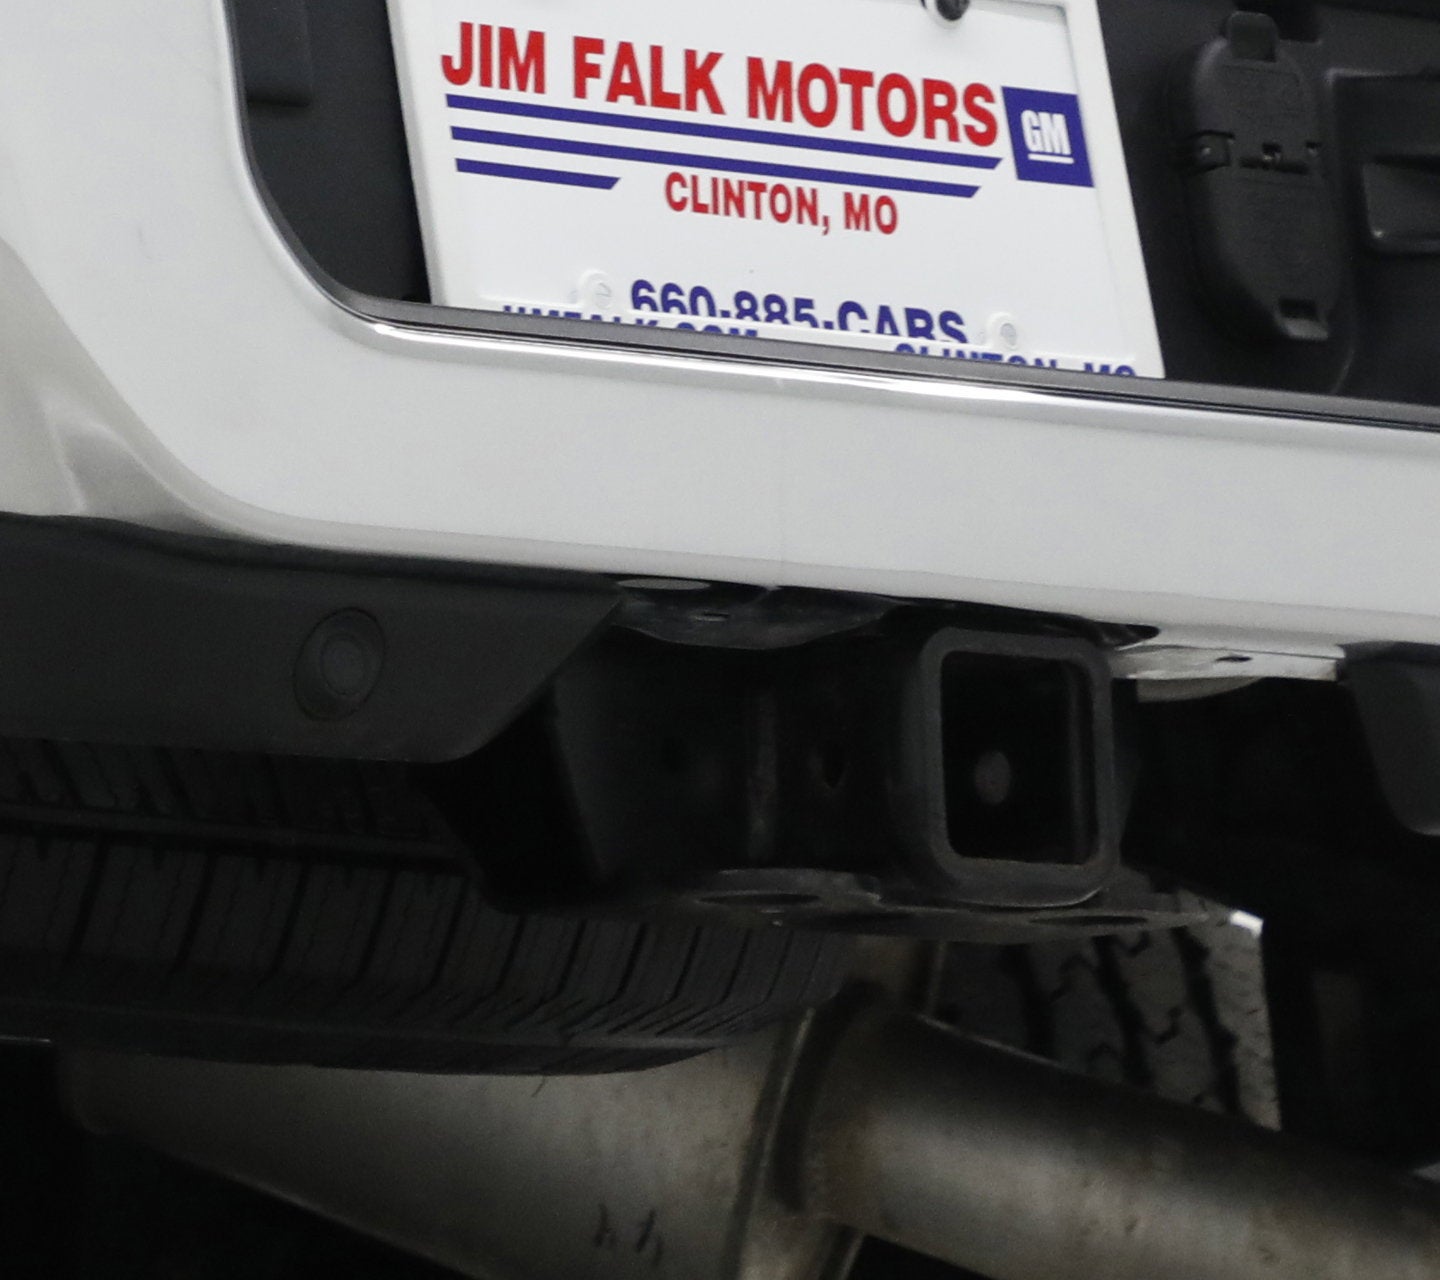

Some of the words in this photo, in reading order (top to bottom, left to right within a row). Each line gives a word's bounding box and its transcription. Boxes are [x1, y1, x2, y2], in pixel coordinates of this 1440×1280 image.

[439, 20, 548, 96] JIM
[571, 34, 727, 117] FALK
[745, 55, 1000, 149] MOTORS
[1019, 108, 1072, 157] GM
[663, 170, 831, 230] CLINTON,
[842, 190, 900, 236] MO
